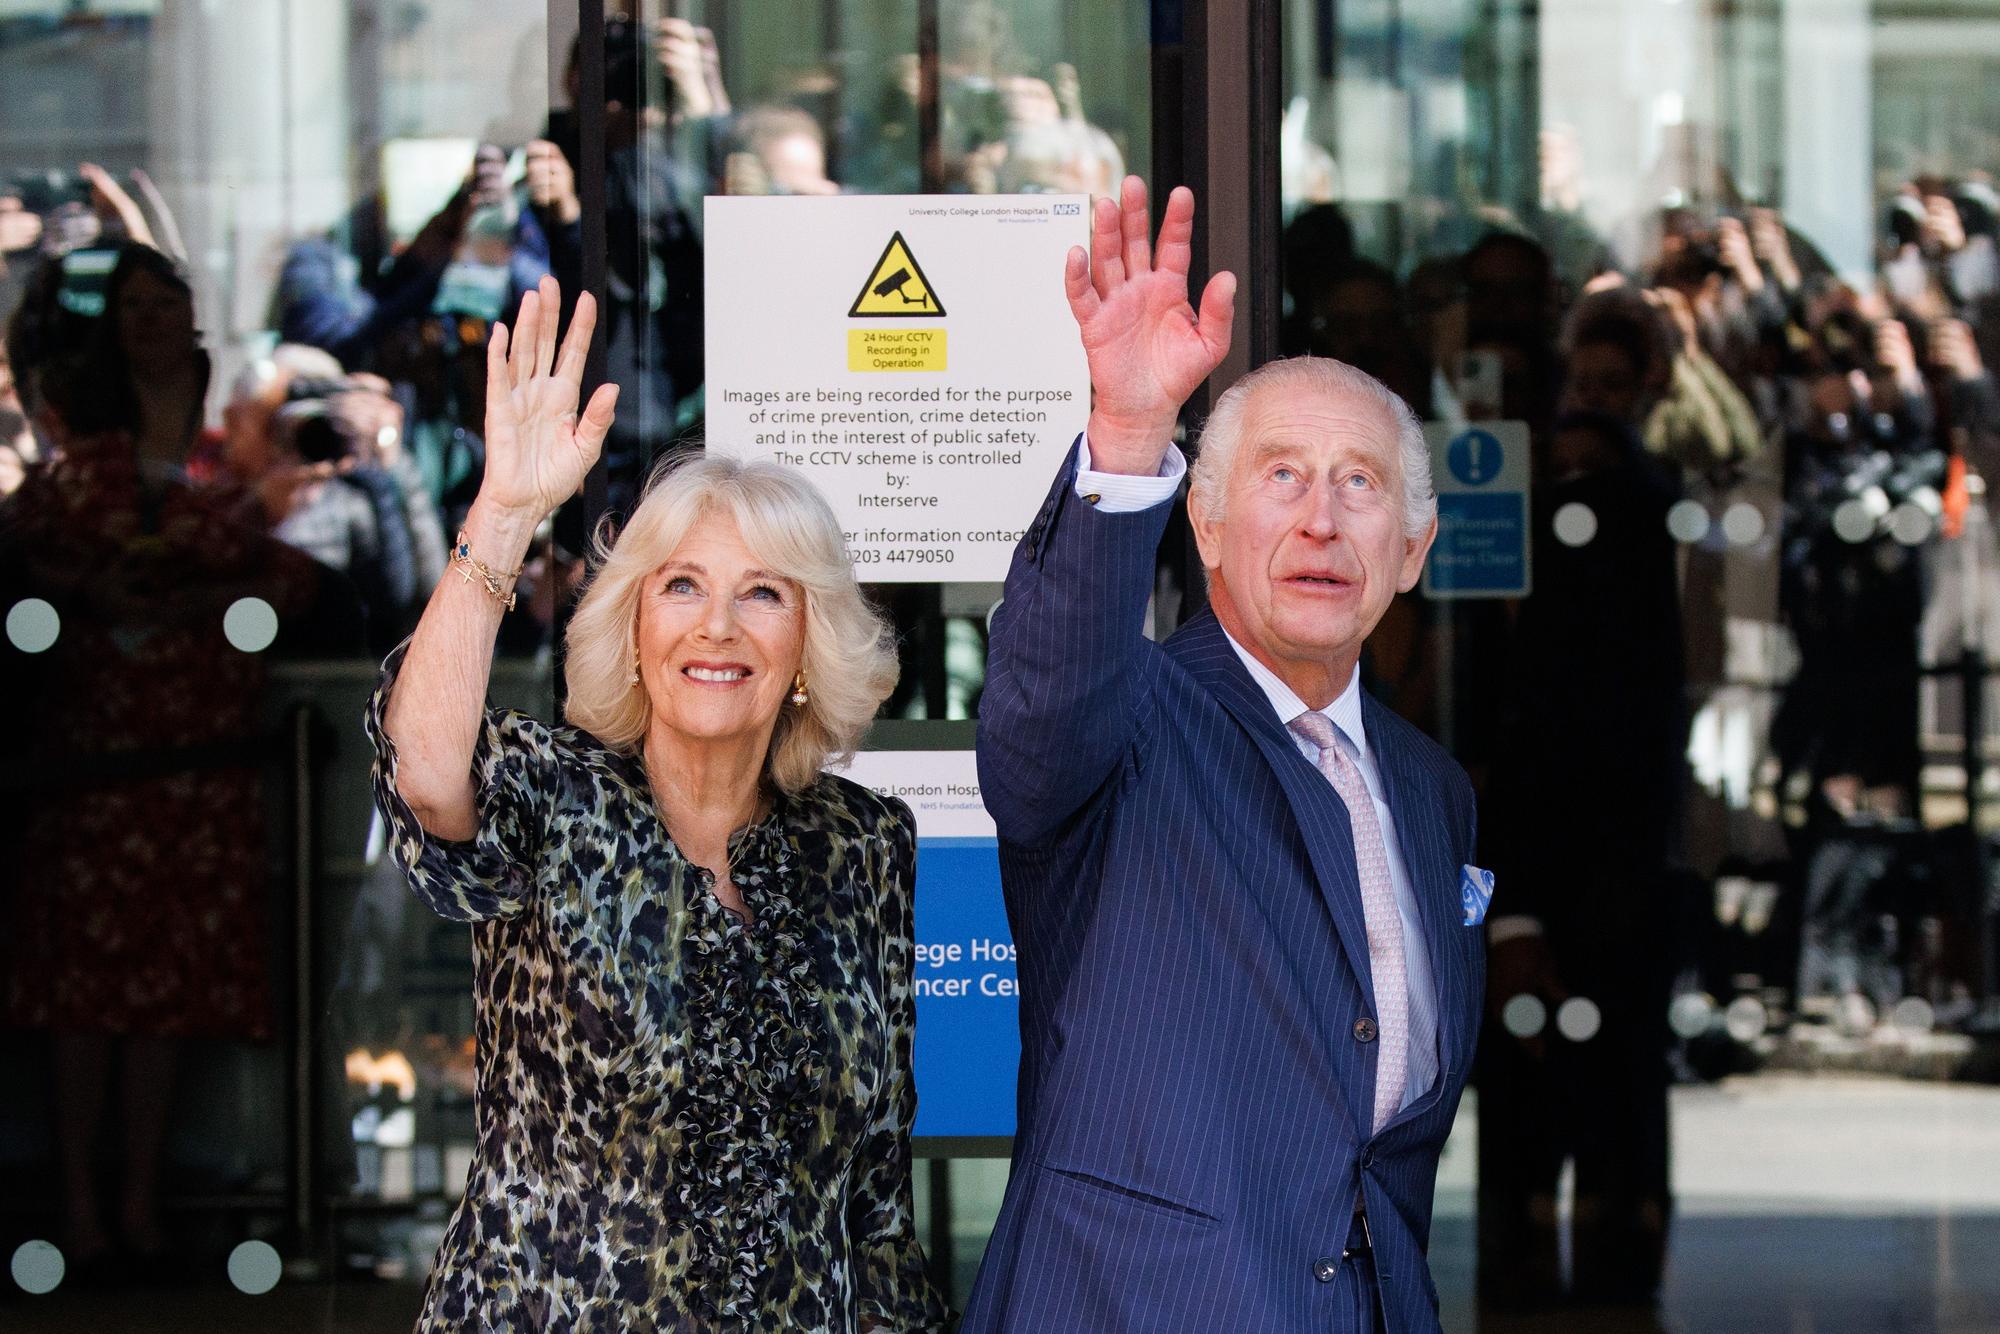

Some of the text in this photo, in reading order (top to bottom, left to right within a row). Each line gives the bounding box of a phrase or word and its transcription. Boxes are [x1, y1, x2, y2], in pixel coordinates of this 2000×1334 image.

[909, 204, 1080, 218] University College London Hospitals NHS
[864, 332, 933, 342] 24 Hour CCTV
[867, 345, 930, 357] Recording in
[873, 358, 924, 369] Operation
[724, 387, 1072, 405] Images are being recorded for the purpose
[749, 408, 1047, 426] of crime prevention, crime detection
[756, 429, 1041, 447] and in the interest of public safety.
[774, 450, 1021, 465] The CCTV scheme is controlled
[886, 472, 909, 488] by:
[858, 493, 938, 508] Interserve
[864, 527, 961, 542] information
[886, 549, 955, 564] 4479050
[892, 784, 942, 796] London
[920, 802, 938, 810] NHS
